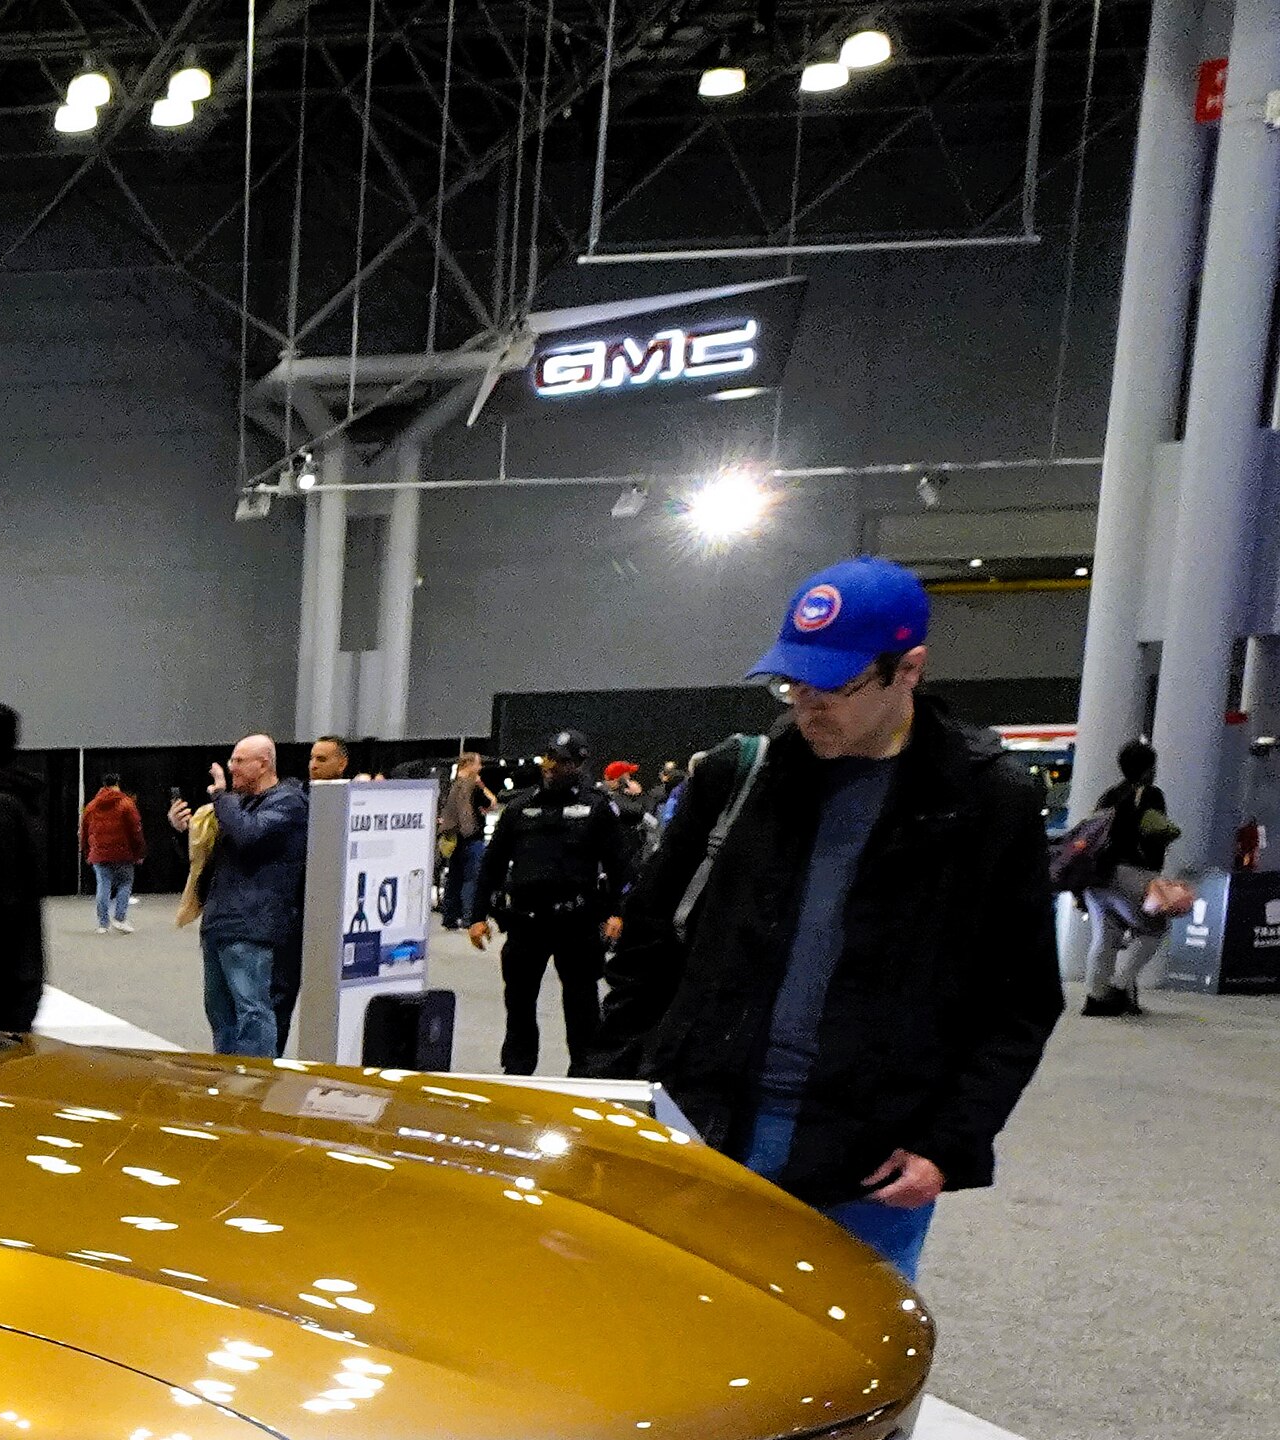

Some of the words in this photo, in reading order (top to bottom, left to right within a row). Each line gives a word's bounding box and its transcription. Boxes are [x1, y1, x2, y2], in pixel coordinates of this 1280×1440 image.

[537, 320, 756, 395] GMC
[350, 815, 371, 832] LEAD
[373, 814, 388, 831] THE
